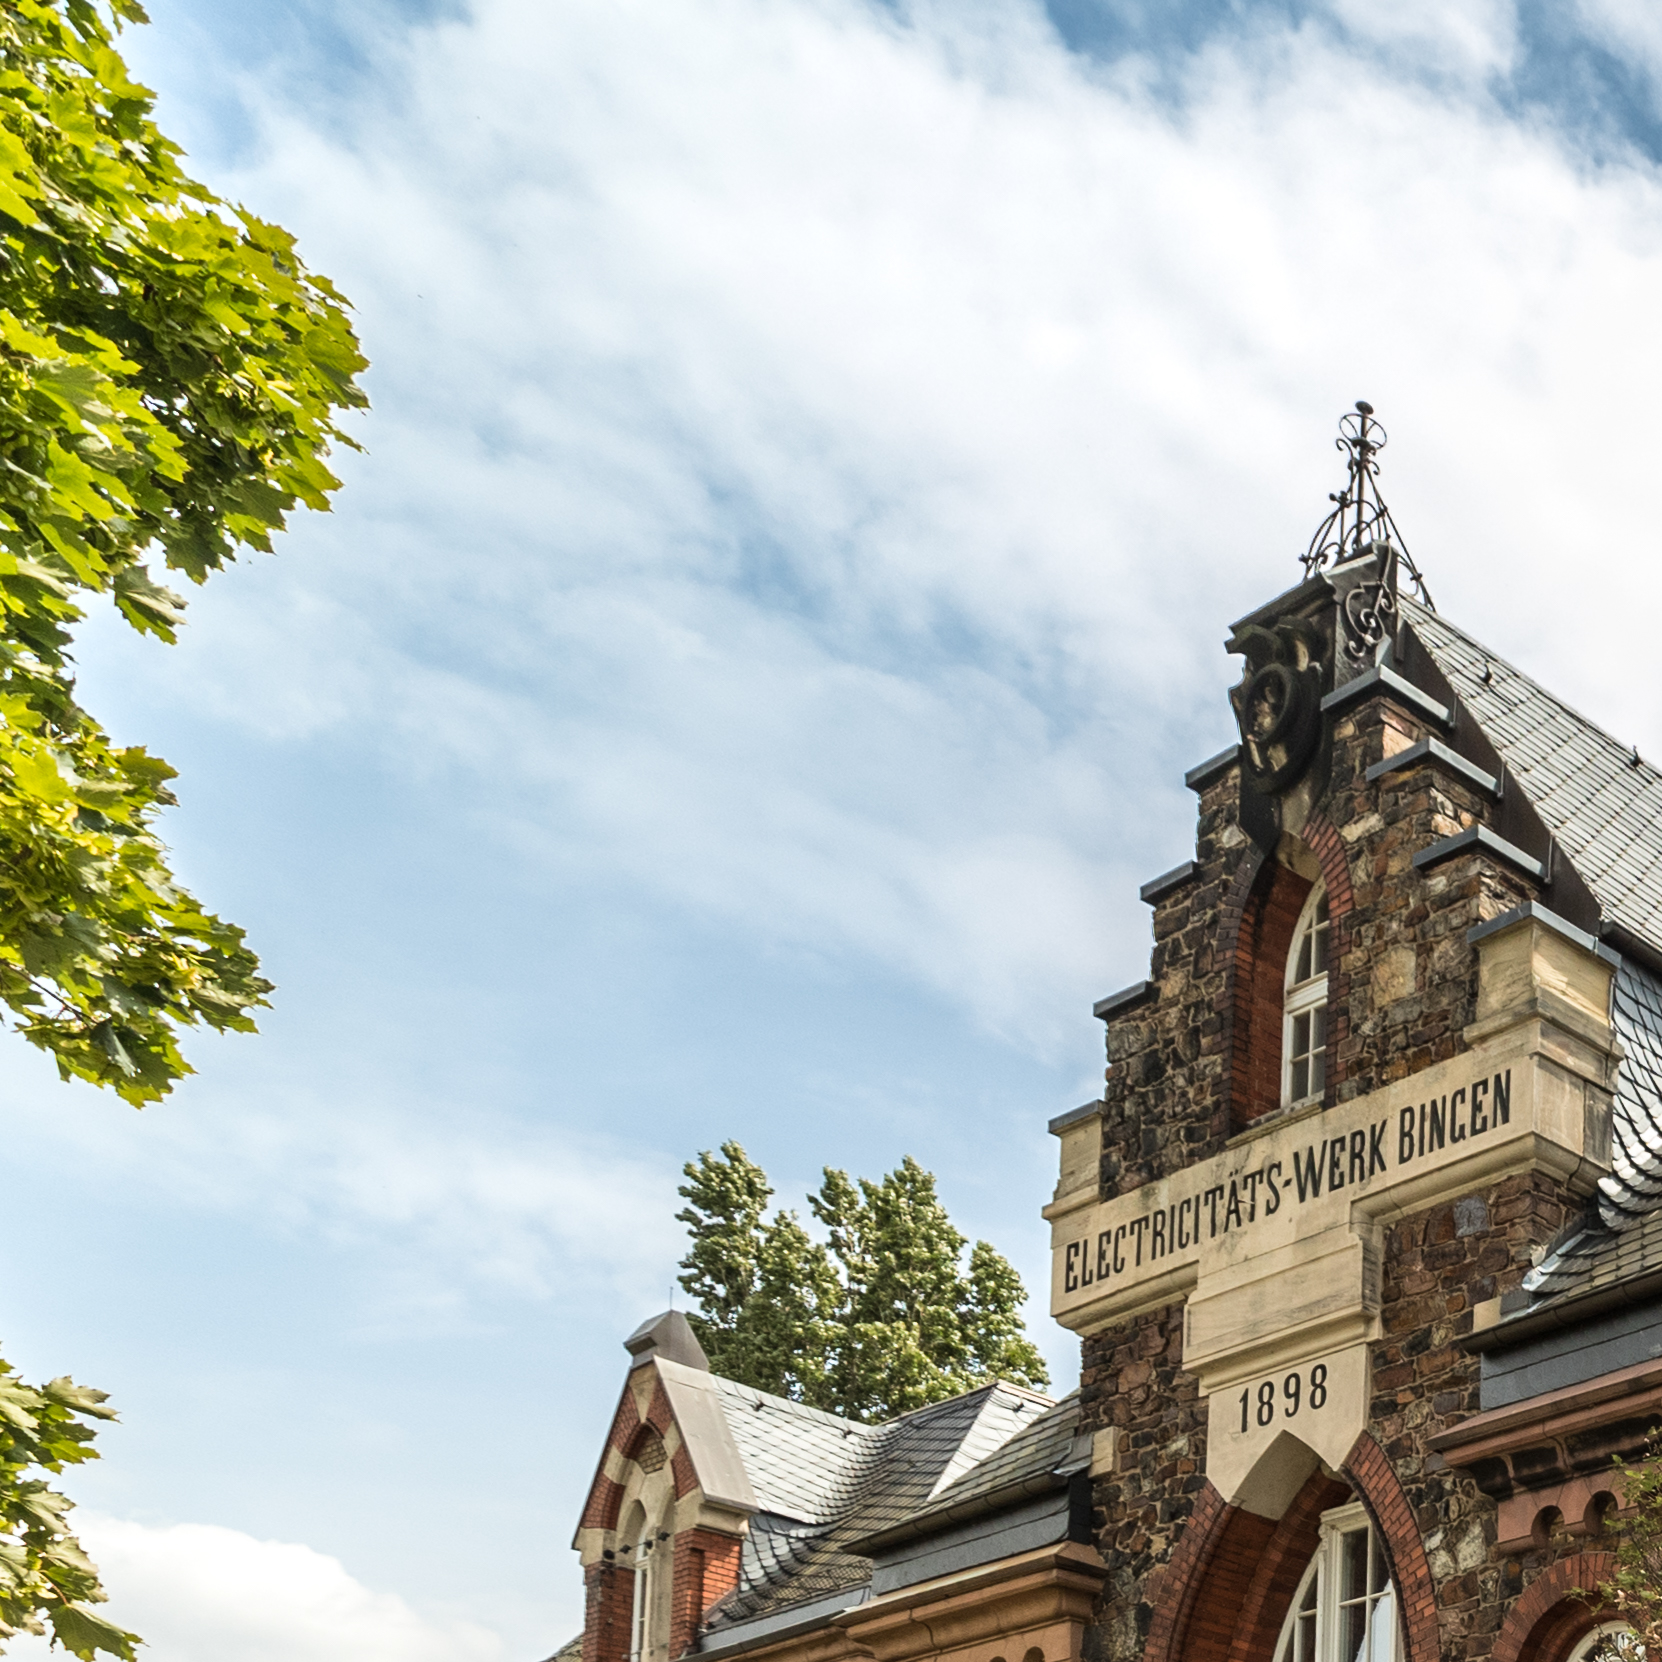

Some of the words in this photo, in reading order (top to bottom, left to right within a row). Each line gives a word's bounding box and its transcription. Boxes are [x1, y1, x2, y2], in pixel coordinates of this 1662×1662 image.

[1064, 1118, 1388, 1294] ELECTRICITÄTS-WERK
[1398, 1068, 1512, 1166] BINGEN
[1238, 1362, 1328, 1433] 1898
